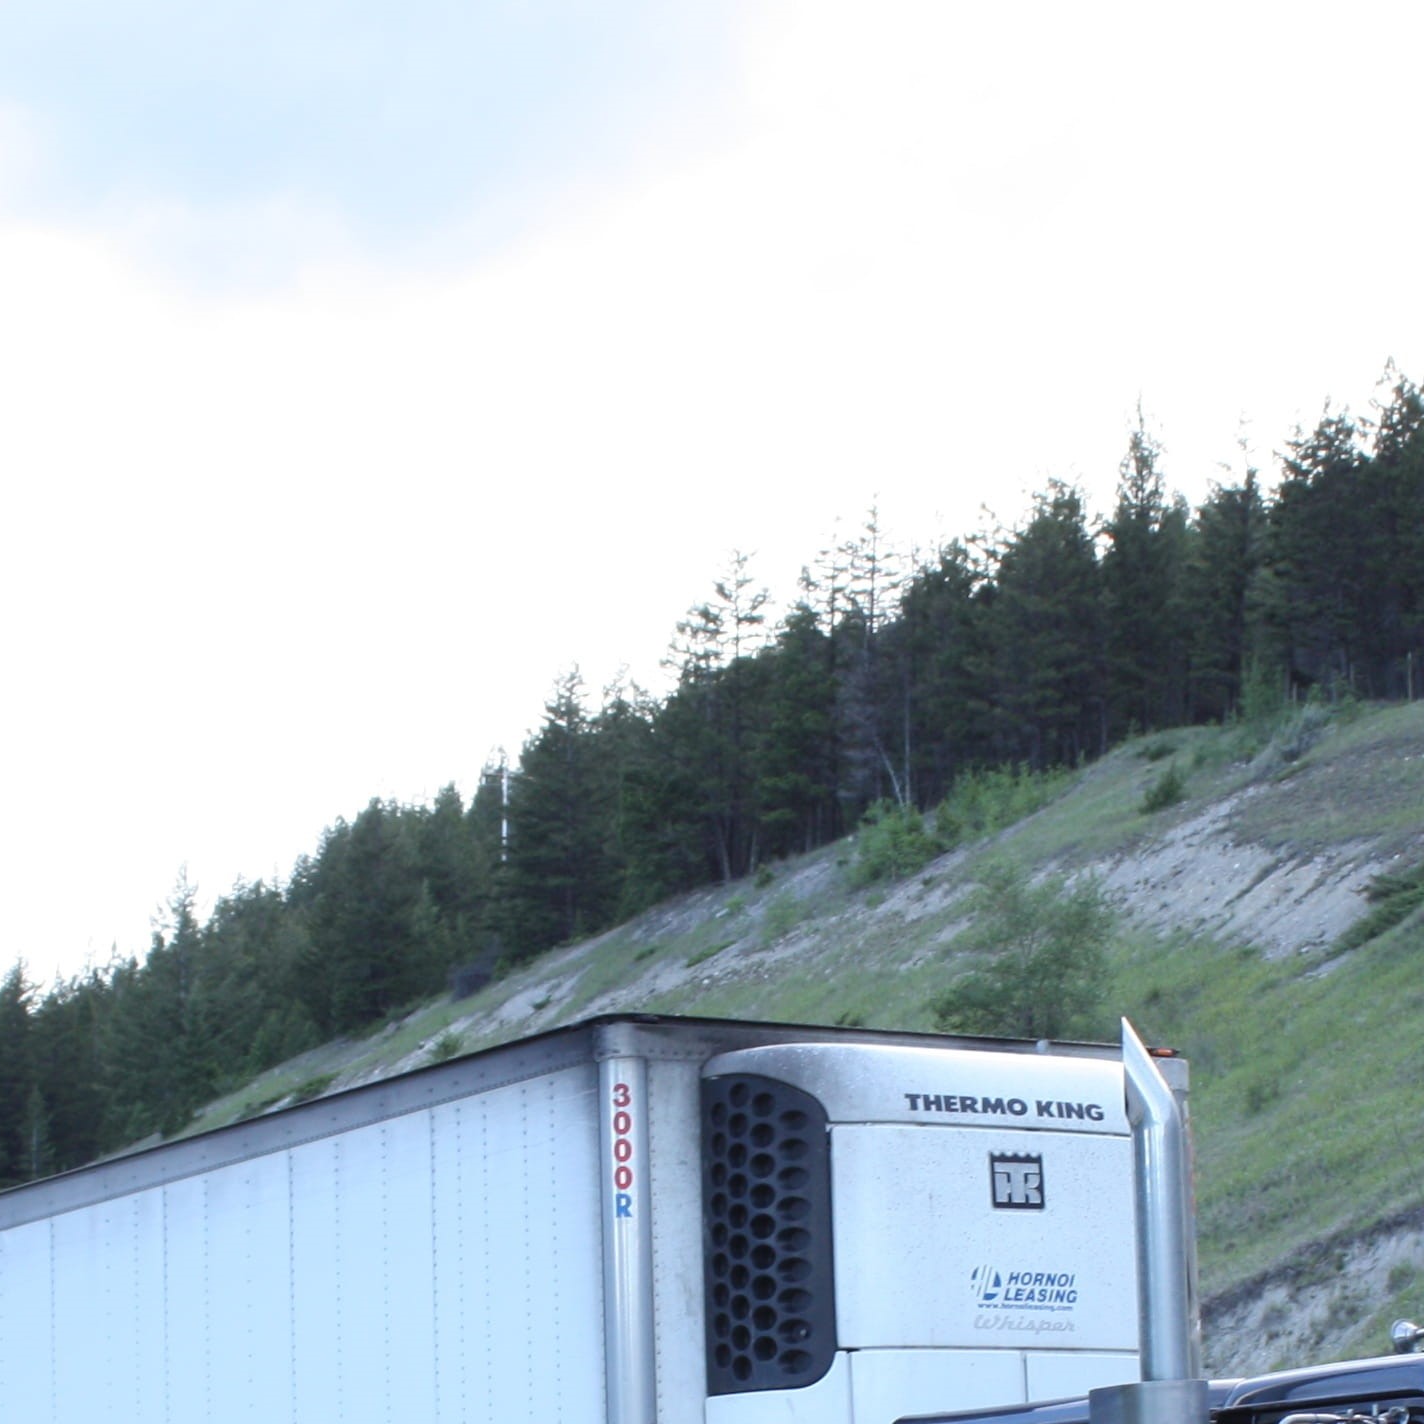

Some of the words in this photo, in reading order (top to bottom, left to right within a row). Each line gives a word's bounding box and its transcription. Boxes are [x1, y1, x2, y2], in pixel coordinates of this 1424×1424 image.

[905, 1093, 1028, 1116] THERMO
[1036, 1100, 1105, 1121] KING
[613, 1083, 633, 1218] 3000R
[1007, 1271, 1075, 1288] HORNOI
[1004, 1287, 1078, 1303] LEASING
[974, 1314, 1075, 1335] Whisper
